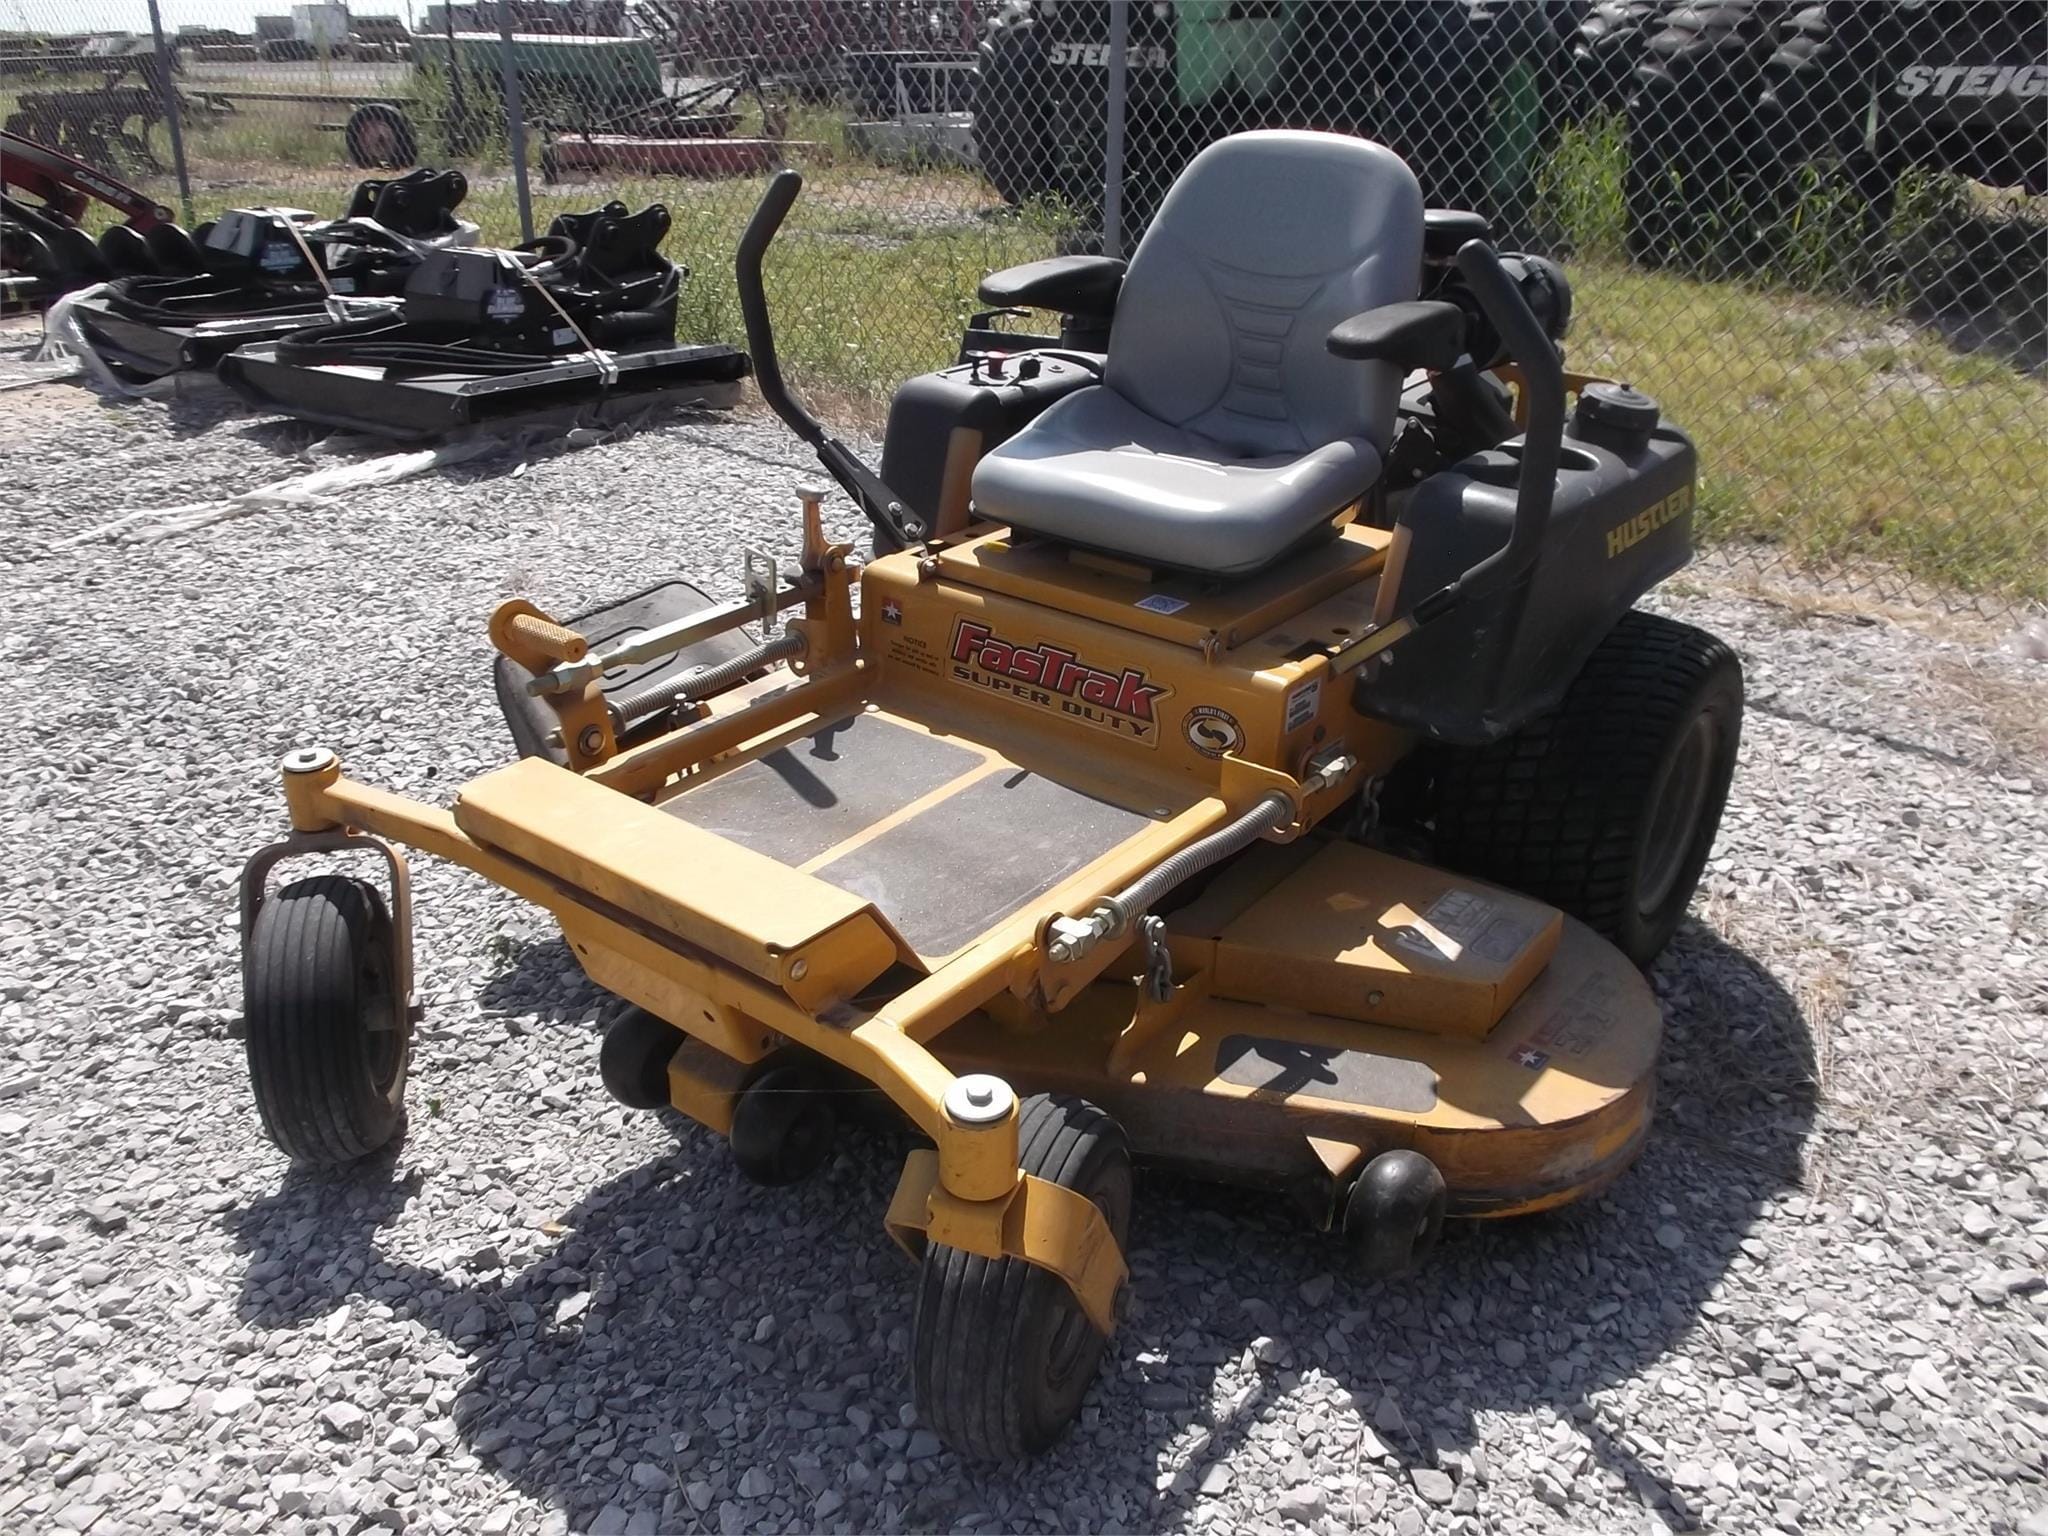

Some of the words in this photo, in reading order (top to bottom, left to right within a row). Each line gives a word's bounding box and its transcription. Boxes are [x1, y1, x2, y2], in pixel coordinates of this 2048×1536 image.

[1049, 42, 1167, 68] STEIER
[1895, 66, 2047, 97] STEIG
[1607, 484, 1692, 560] HUSTLER
[950, 619, 1172, 722] FasTrak
[952, 665, 1051, 707] SUPER
[1062, 699, 1151, 738] DUTY
